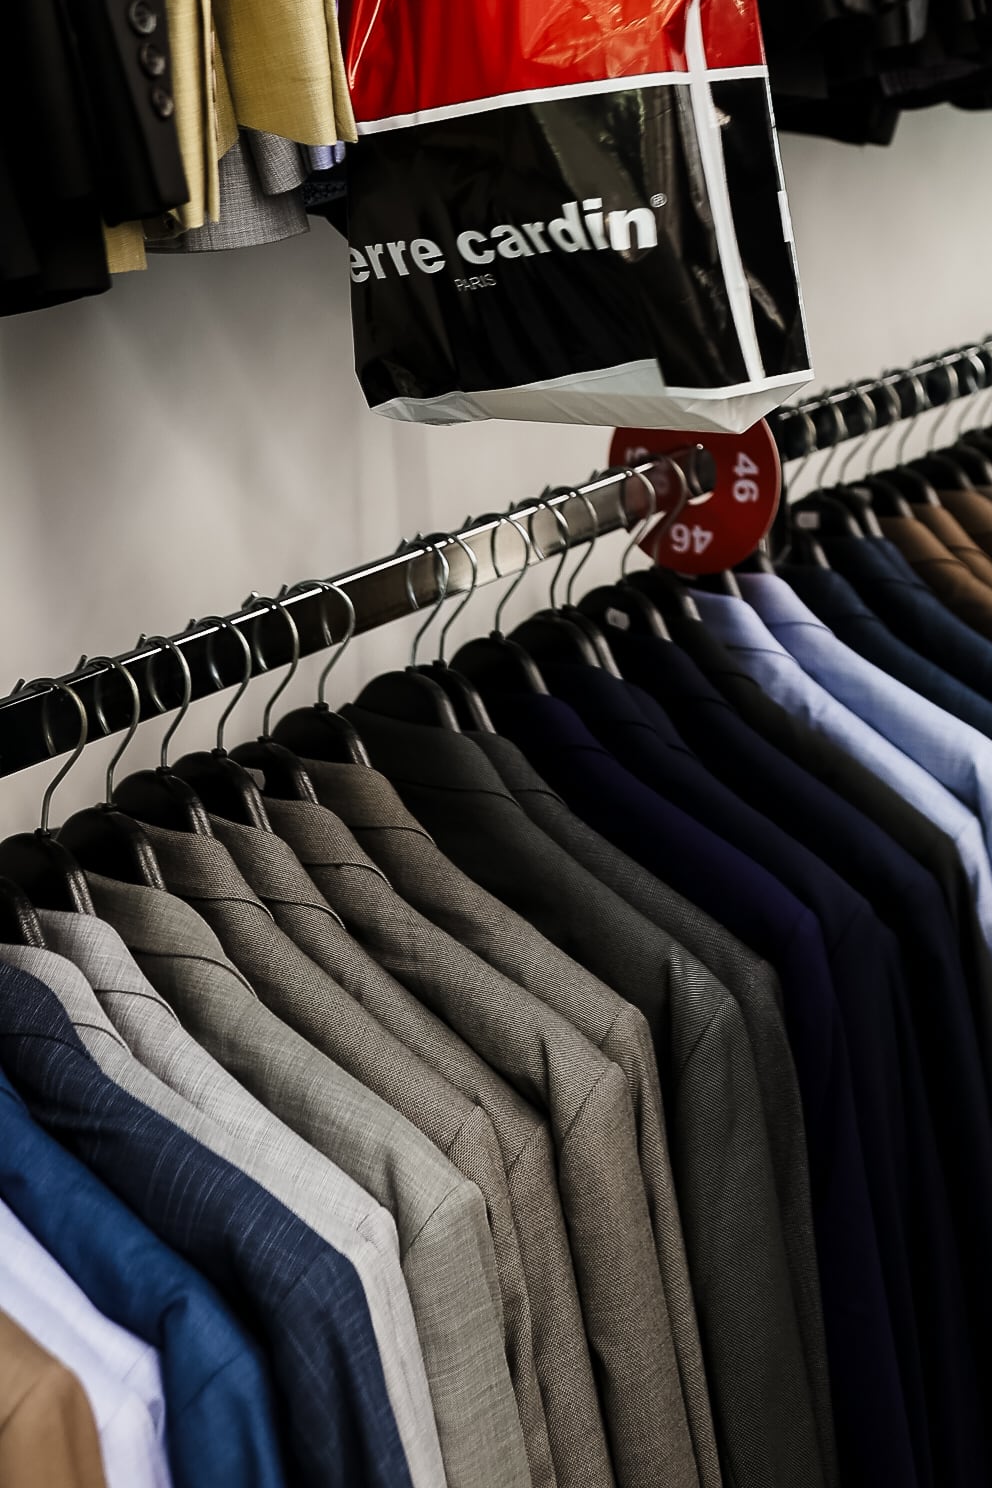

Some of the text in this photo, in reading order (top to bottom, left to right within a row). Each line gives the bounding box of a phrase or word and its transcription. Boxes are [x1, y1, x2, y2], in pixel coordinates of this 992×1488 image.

[456, 197, 658, 265] cardin
[453, 273, 497, 292] PARIS
[732, 452, 760, 503] 46
[669, 523, 713, 554] 46
